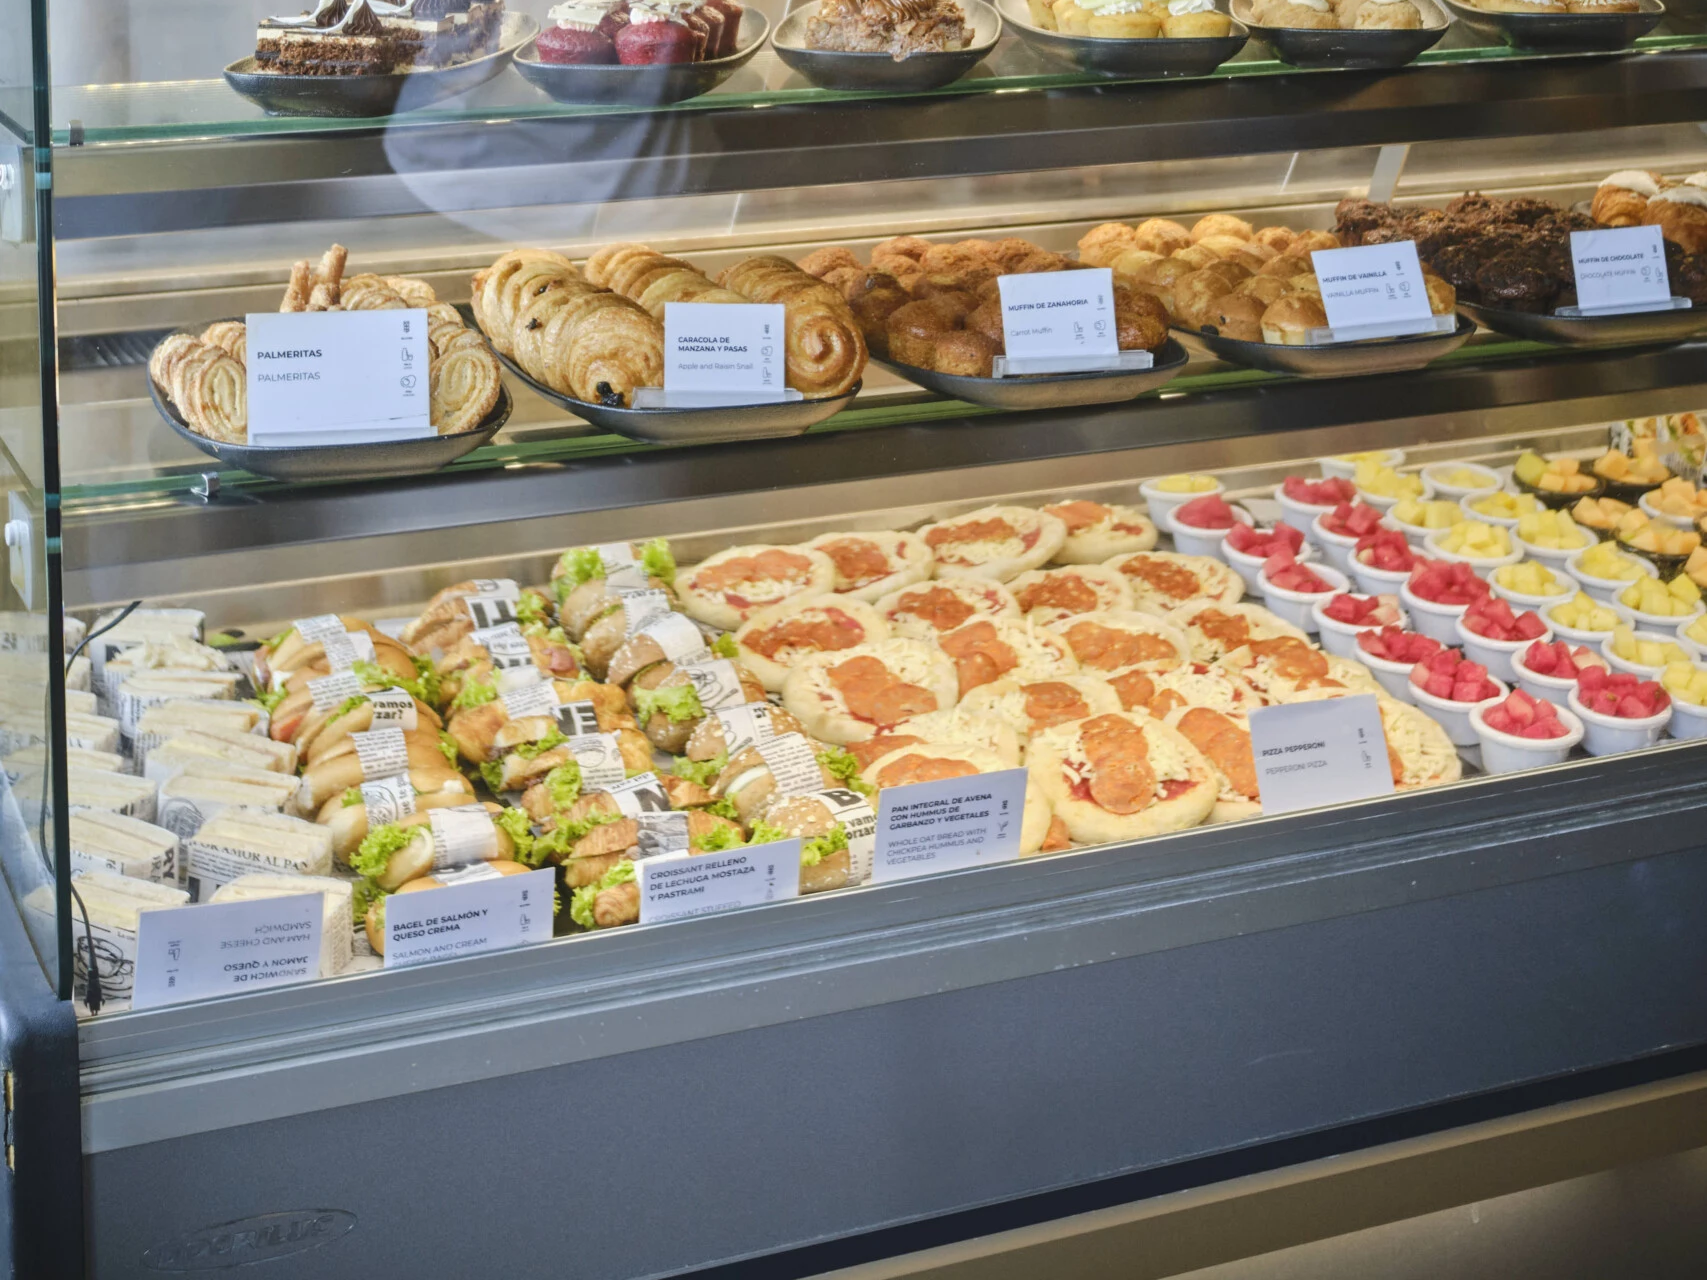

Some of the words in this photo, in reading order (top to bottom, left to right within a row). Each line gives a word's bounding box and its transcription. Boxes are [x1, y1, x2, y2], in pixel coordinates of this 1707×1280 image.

[1008, 303, 1034, 312] MUFFIN
[1047, 299, 1089, 308] ZANAHORIA
[1010, 329, 1030, 337] Carrot
[257, 349, 322, 359] PALMERITAS
[257, 371, 321, 382] PALMERITAS
[1262, 748, 1283, 757] PIZZA
[1284, 741, 1326, 753] PEPPERONI
[891, 805, 908, 813] PAN
[910, 799, 949, 811] INTEGRAL
[951, 796, 963, 804] DE
[964, 793, 992, 803] AVENA
[889, 818, 935, 830] GARBANZO
[944, 810, 989, 822] VEGETALES
[890, 813, 908, 822] CON
[910, 808, 947, 819] HUMMUS
[888, 837, 918, 848] WHOLE
[919, 834, 935, 843] OAT
[937, 830, 964, 840] BREAD
[965, 827, 987, 836] WITH
[887, 845, 927, 857] CHICKPEA
[928, 839, 965, 851] HUMMUS
[967, 836, 984, 845] AND
[886, 852, 936, 866] VEGETABLES
[650, 864, 703, 880] CROISSANT
[705, 856, 747, 871] RELLENO
[649, 882, 662, 891] DE
[665, 874, 709, 889] LECHUGA
[711, 865, 756, 880] MOSTAZA
[658, 886, 705, 901] PASTRAMI
[393, 920, 424, 932] BAGEL
[426, 917, 439, 926] DE
[440, 910, 480, 924] SALMÓN
[482, 908, 488, 917] Y
[287, 933, 310, 943] HAM
[392, 929, 425, 942] QUESO
[427, 923, 461, 936] CREMA
[220, 938, 260, 949] CHEESE
[262, 936, 285, 946] AND
[392, 946, 431, 961] SALMON
[433, 943, 453, 953] AND
[455, 937, 488, 950] CREAM
[223, 960, 259, 971] QUESO
[262, 960, 268, 968] Y
[271, 956, 308, 967] JAMON
[233, 974, 247, 983] DE
[249, 967, 307, 981] SANDWICH
